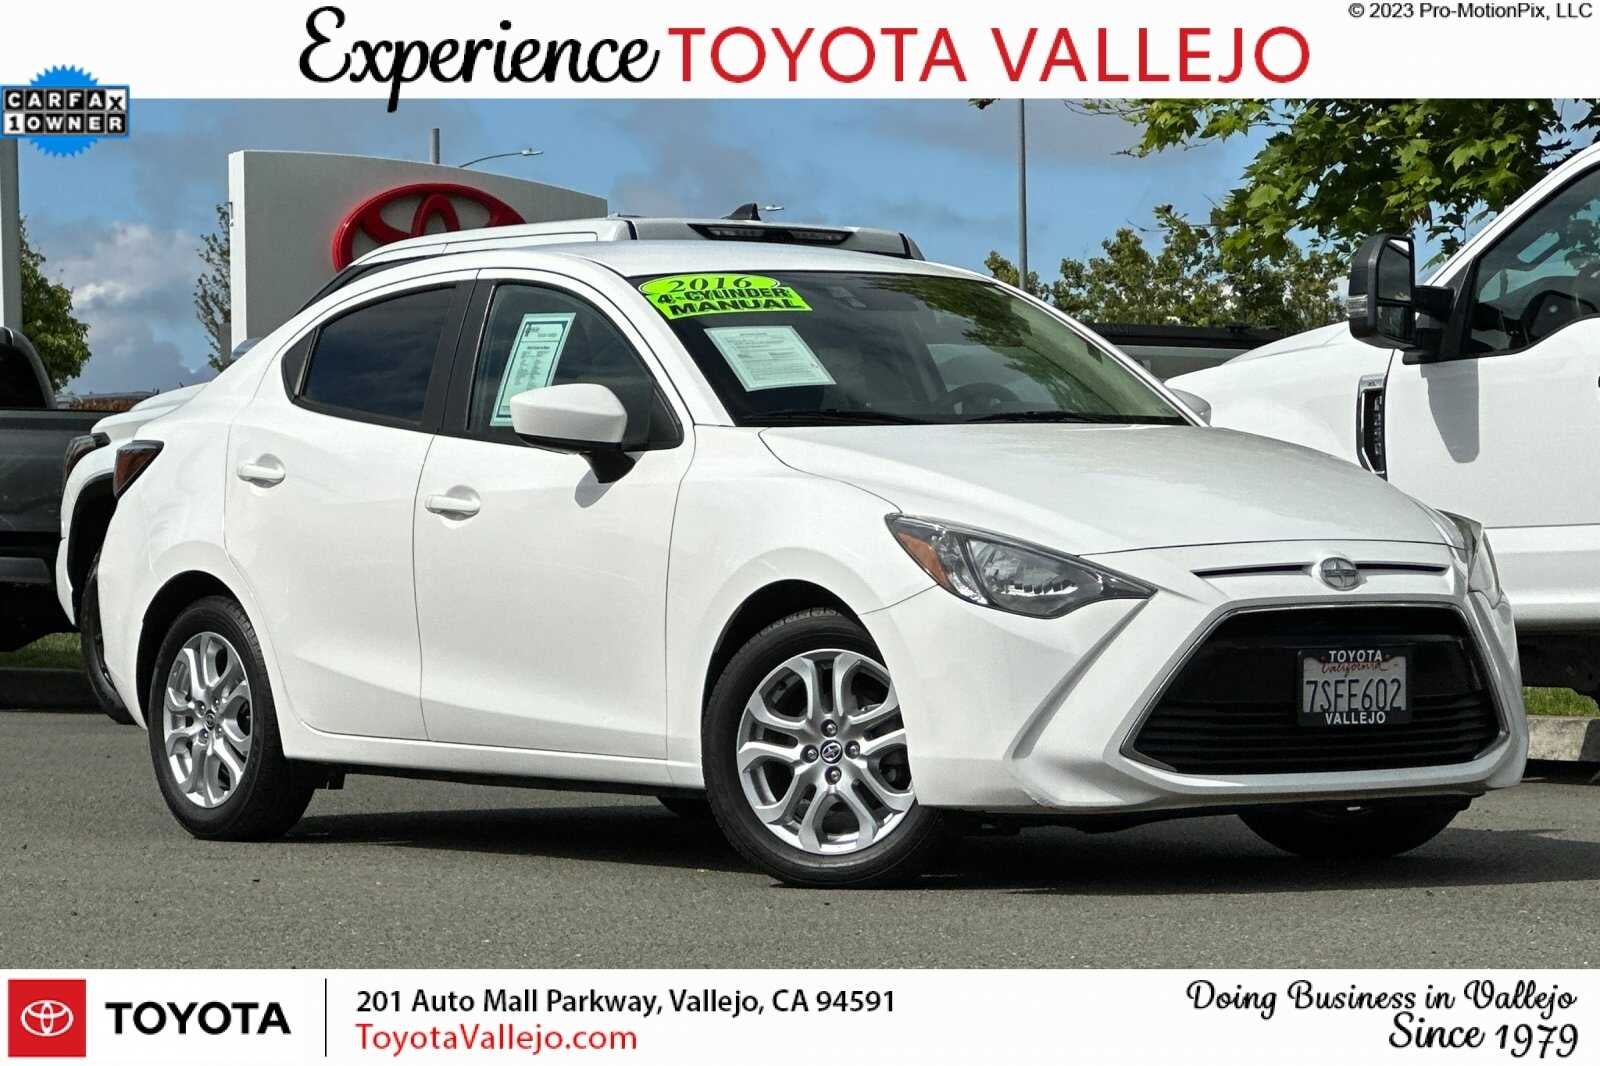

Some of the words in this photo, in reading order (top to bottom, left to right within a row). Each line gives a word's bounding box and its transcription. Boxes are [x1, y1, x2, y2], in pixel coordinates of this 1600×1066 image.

[668, 276, 753, 293] 2016
[668, 298, 802, 316] MANUAL
[1328, 649, 1383, 663] TOYOTA
[1305, 678, 1403, 713] 7SFE602
[1325, 711, 1386, 725] VALLEJO
